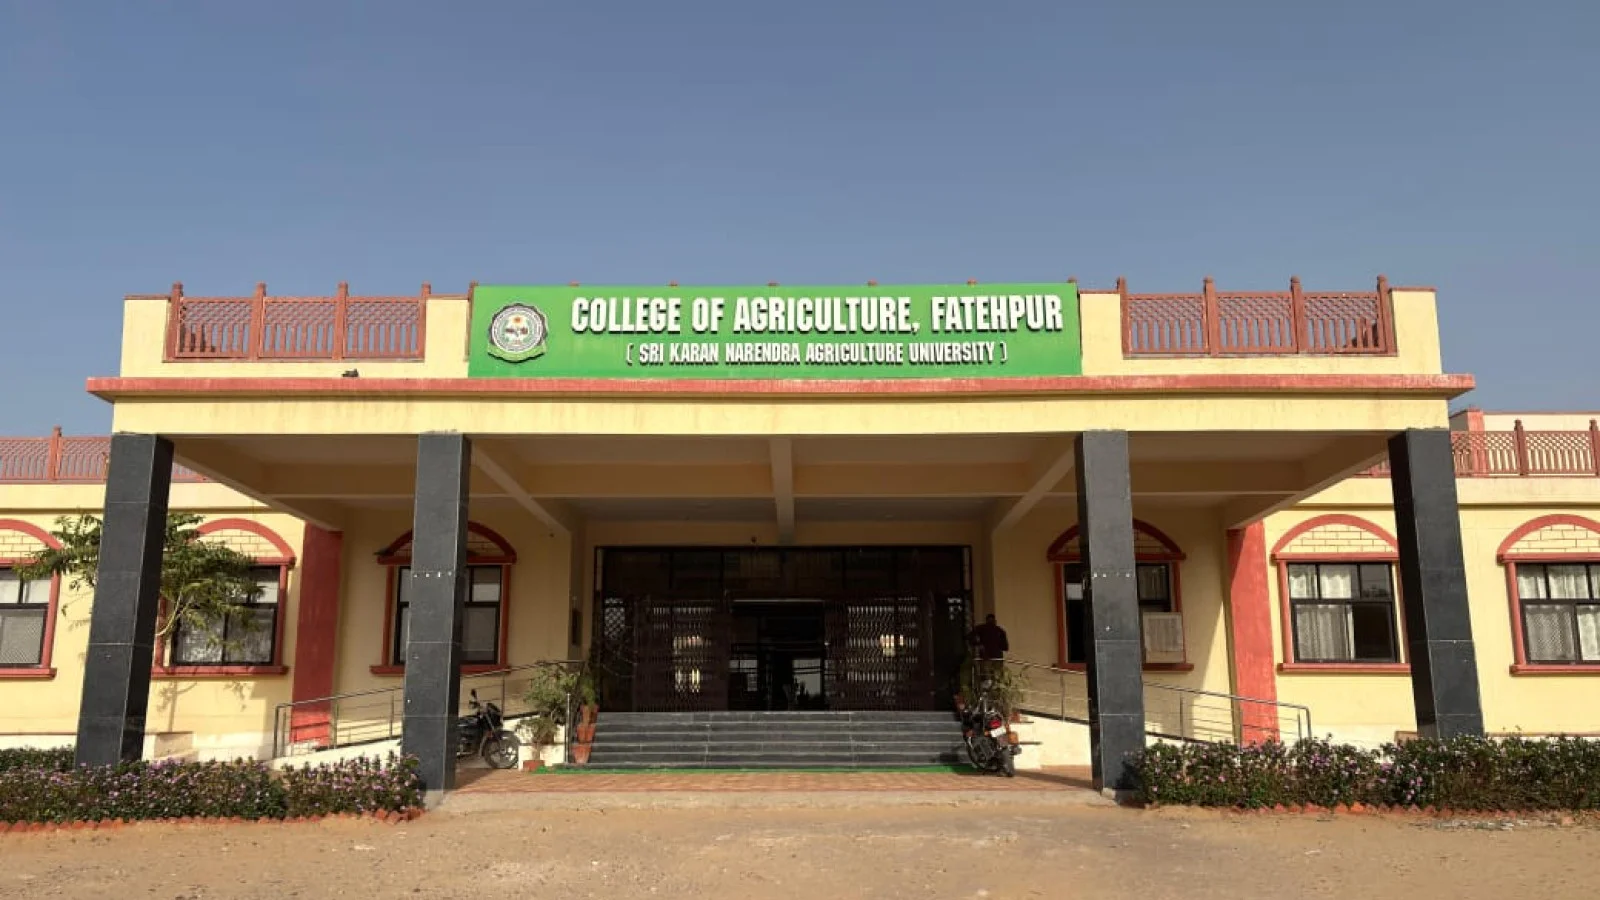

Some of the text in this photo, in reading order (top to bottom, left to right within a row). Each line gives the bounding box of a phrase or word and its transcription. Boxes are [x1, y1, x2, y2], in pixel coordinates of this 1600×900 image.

[571, 297, 682, 333] COLLEGE
[692, 297, 724, 333] OF
[734, 296, 920, 334] AGRICULTURE,
[931, 295, 1063, 332] FATEHPUR
[639, 343, 664, 364] SRI
[670, 343, 719, 364] KARAN
[725, 343, 800, 364] NARENDRA
[805, 342, 903, 364] AGRICULTURE
[908, 341, 995, 363] UNIVERSITY
